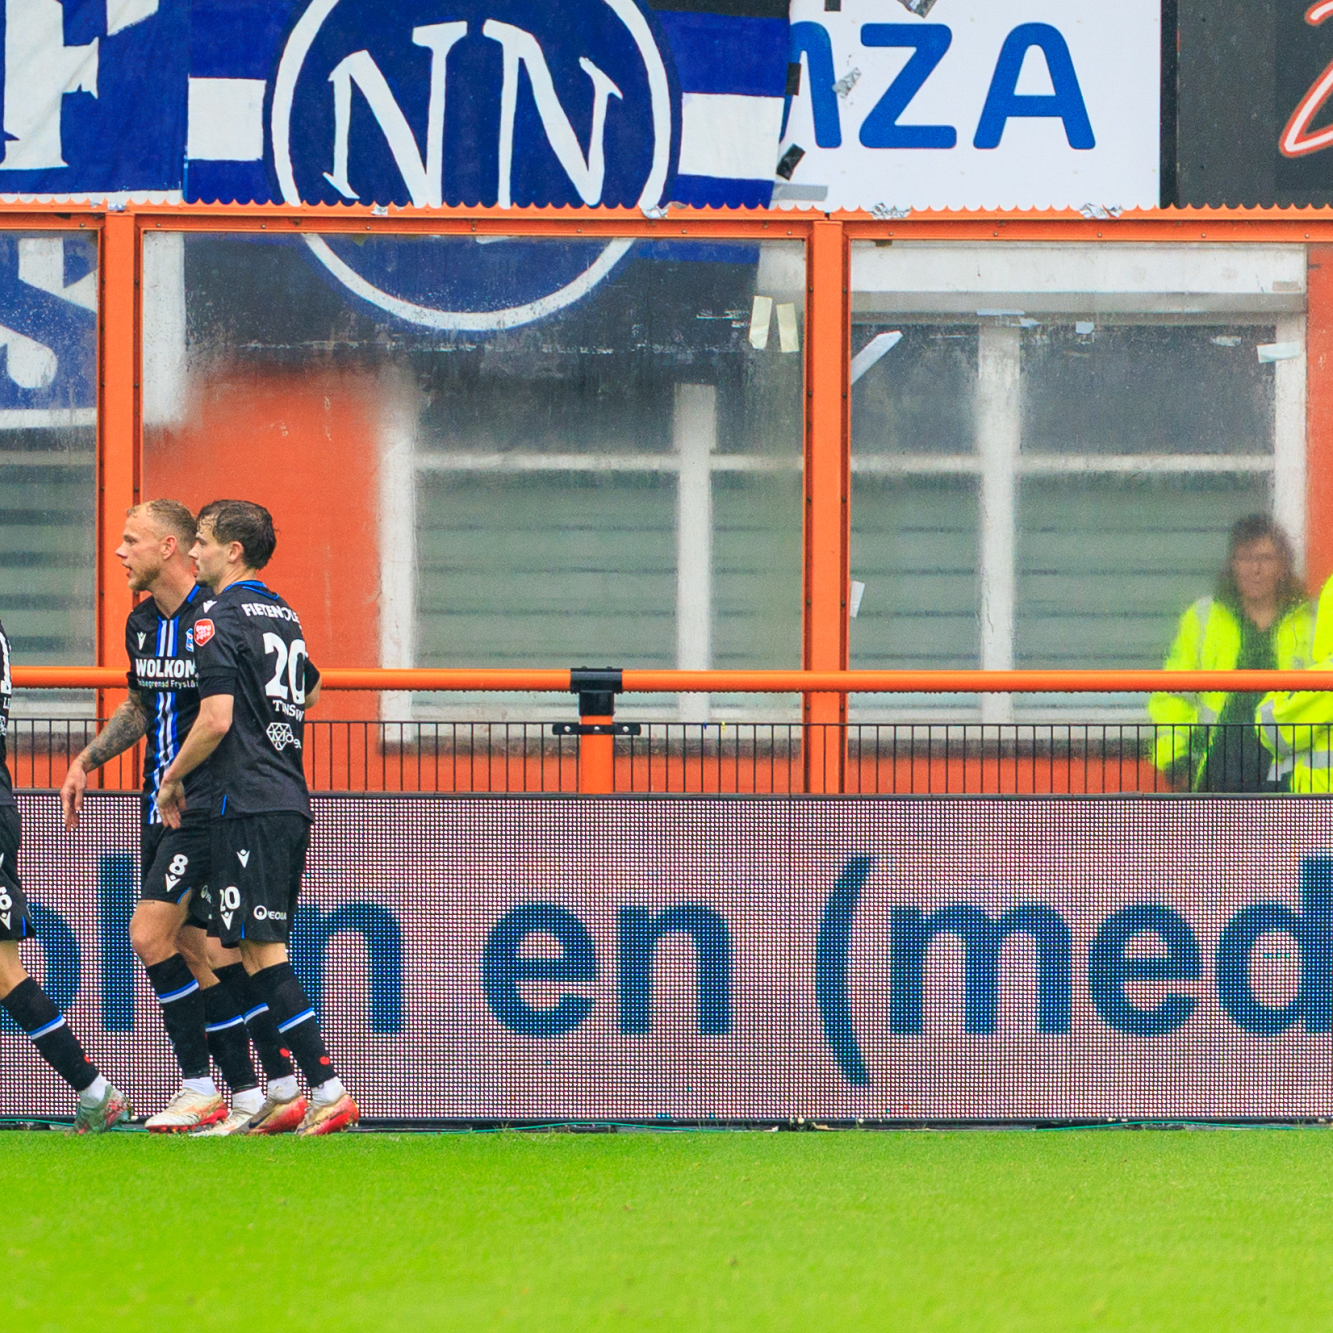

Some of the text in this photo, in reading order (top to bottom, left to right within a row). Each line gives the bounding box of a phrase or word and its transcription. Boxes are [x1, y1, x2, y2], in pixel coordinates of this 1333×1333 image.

[323, 19, 624, 226] NN
[263, 632, 306, 705] 20
[169, 854, 188, 876] 8
[482, 900, 732, 1037] en
